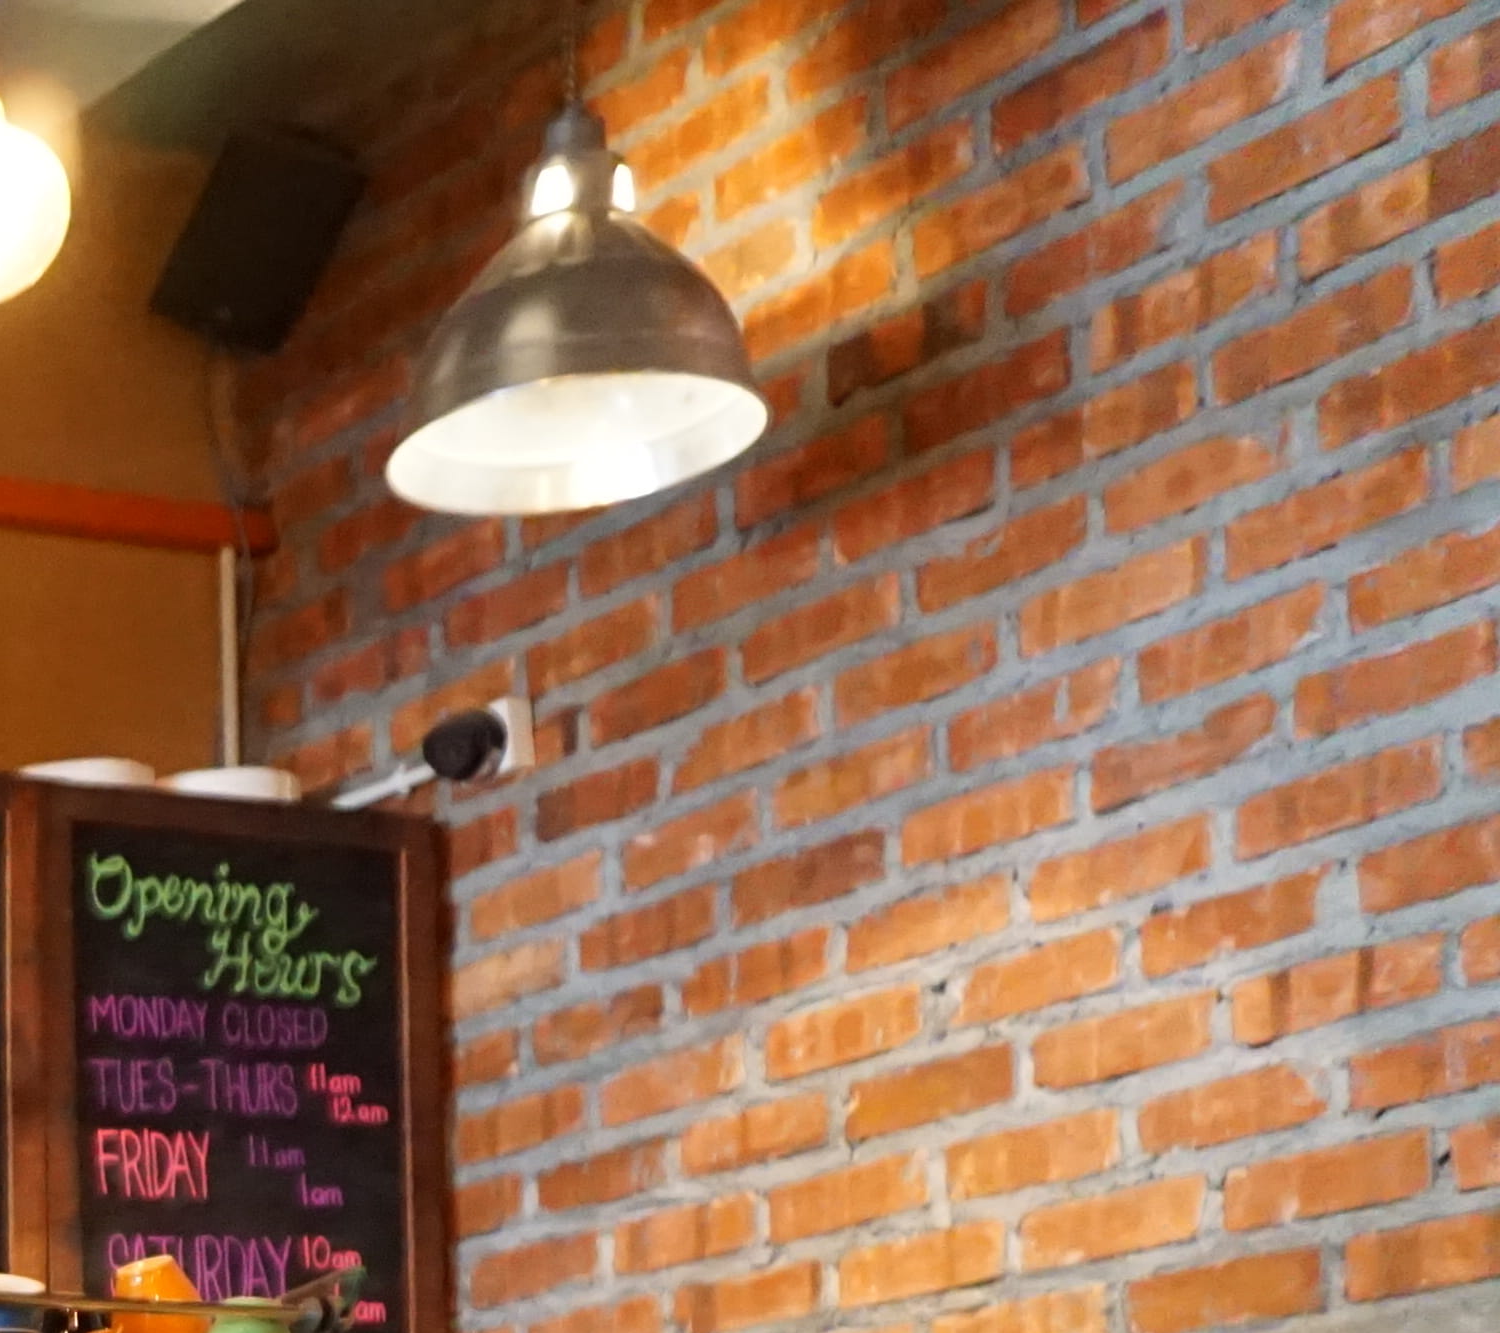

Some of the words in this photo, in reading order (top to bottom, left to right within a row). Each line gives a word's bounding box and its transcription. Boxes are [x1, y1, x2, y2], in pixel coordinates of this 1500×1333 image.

[88, 852, 320, 956] Opening
[203, 925, 378, 1008] Hours
[88, 995, 210, 1041] MONDAY
[221, 1002, 329, 1049] CLOSED
[307, 1062, 363, 1095] 11am
[330, 1096, 390, 1125] 12am
[95, 1127, 211, 1201] FRIDAY
[246, 1133, 307, 1169] 11am
[298, 1172, 345, 1209] 1am
[302, 1234, 363, 1270] 10am
